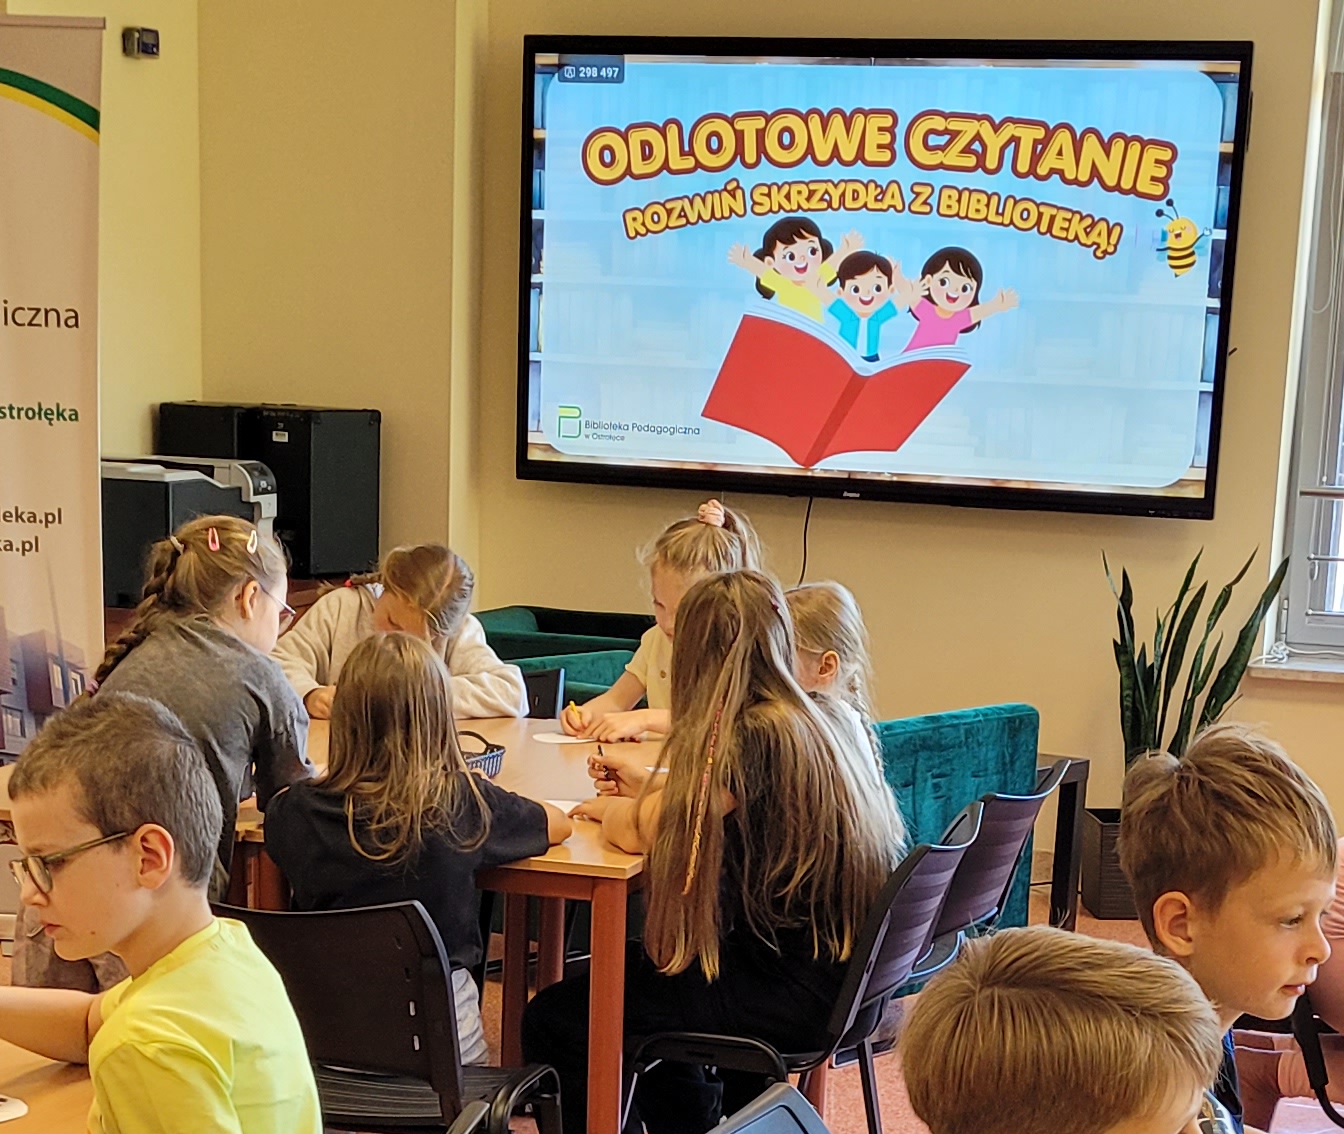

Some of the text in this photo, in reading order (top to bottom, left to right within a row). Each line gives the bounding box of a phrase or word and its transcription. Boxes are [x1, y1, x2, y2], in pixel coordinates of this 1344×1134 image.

[578, 66, 620, 79] 298 497
[584, 110, 1176, 198] ODLOTOWE CZYTANIE
[624, 180, 1123, 259] ROZWIŃ SKRZYDŁA Z BIBLIOTEKĄ!
[584, 420, 701, 436] Biblioteka Pedagogiczna
